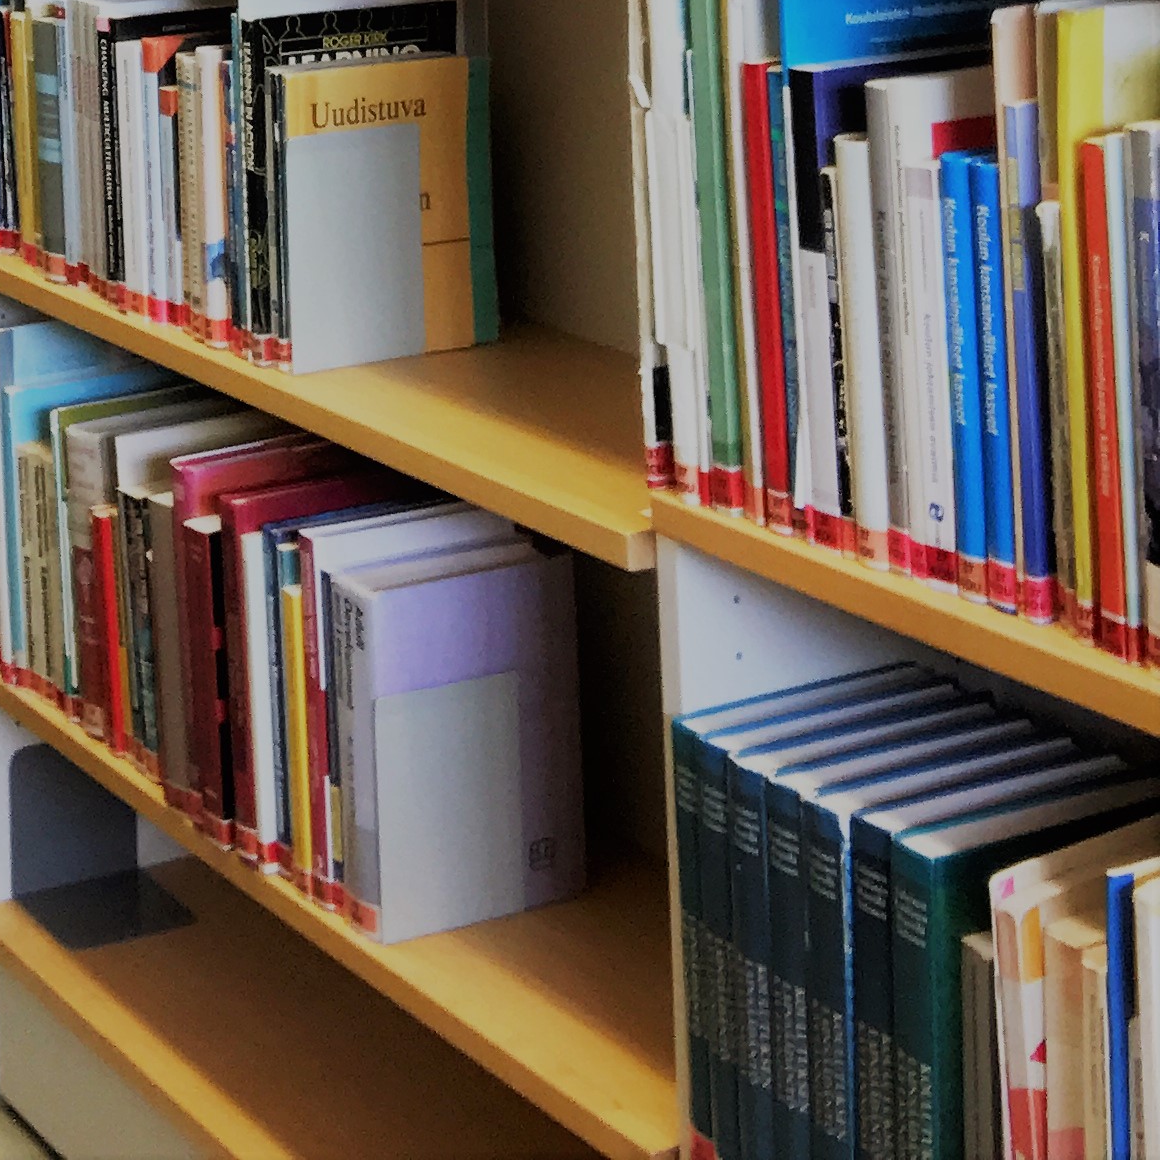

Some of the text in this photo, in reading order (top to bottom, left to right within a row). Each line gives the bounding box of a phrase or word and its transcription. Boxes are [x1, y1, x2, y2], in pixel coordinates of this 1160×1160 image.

[323, 32, 361, 49] ROGER
[310, 96, 427, 129] Uudistuva
[943, 198, 959, 253] Koulun
[975, 204, 992, 258] Koulun
